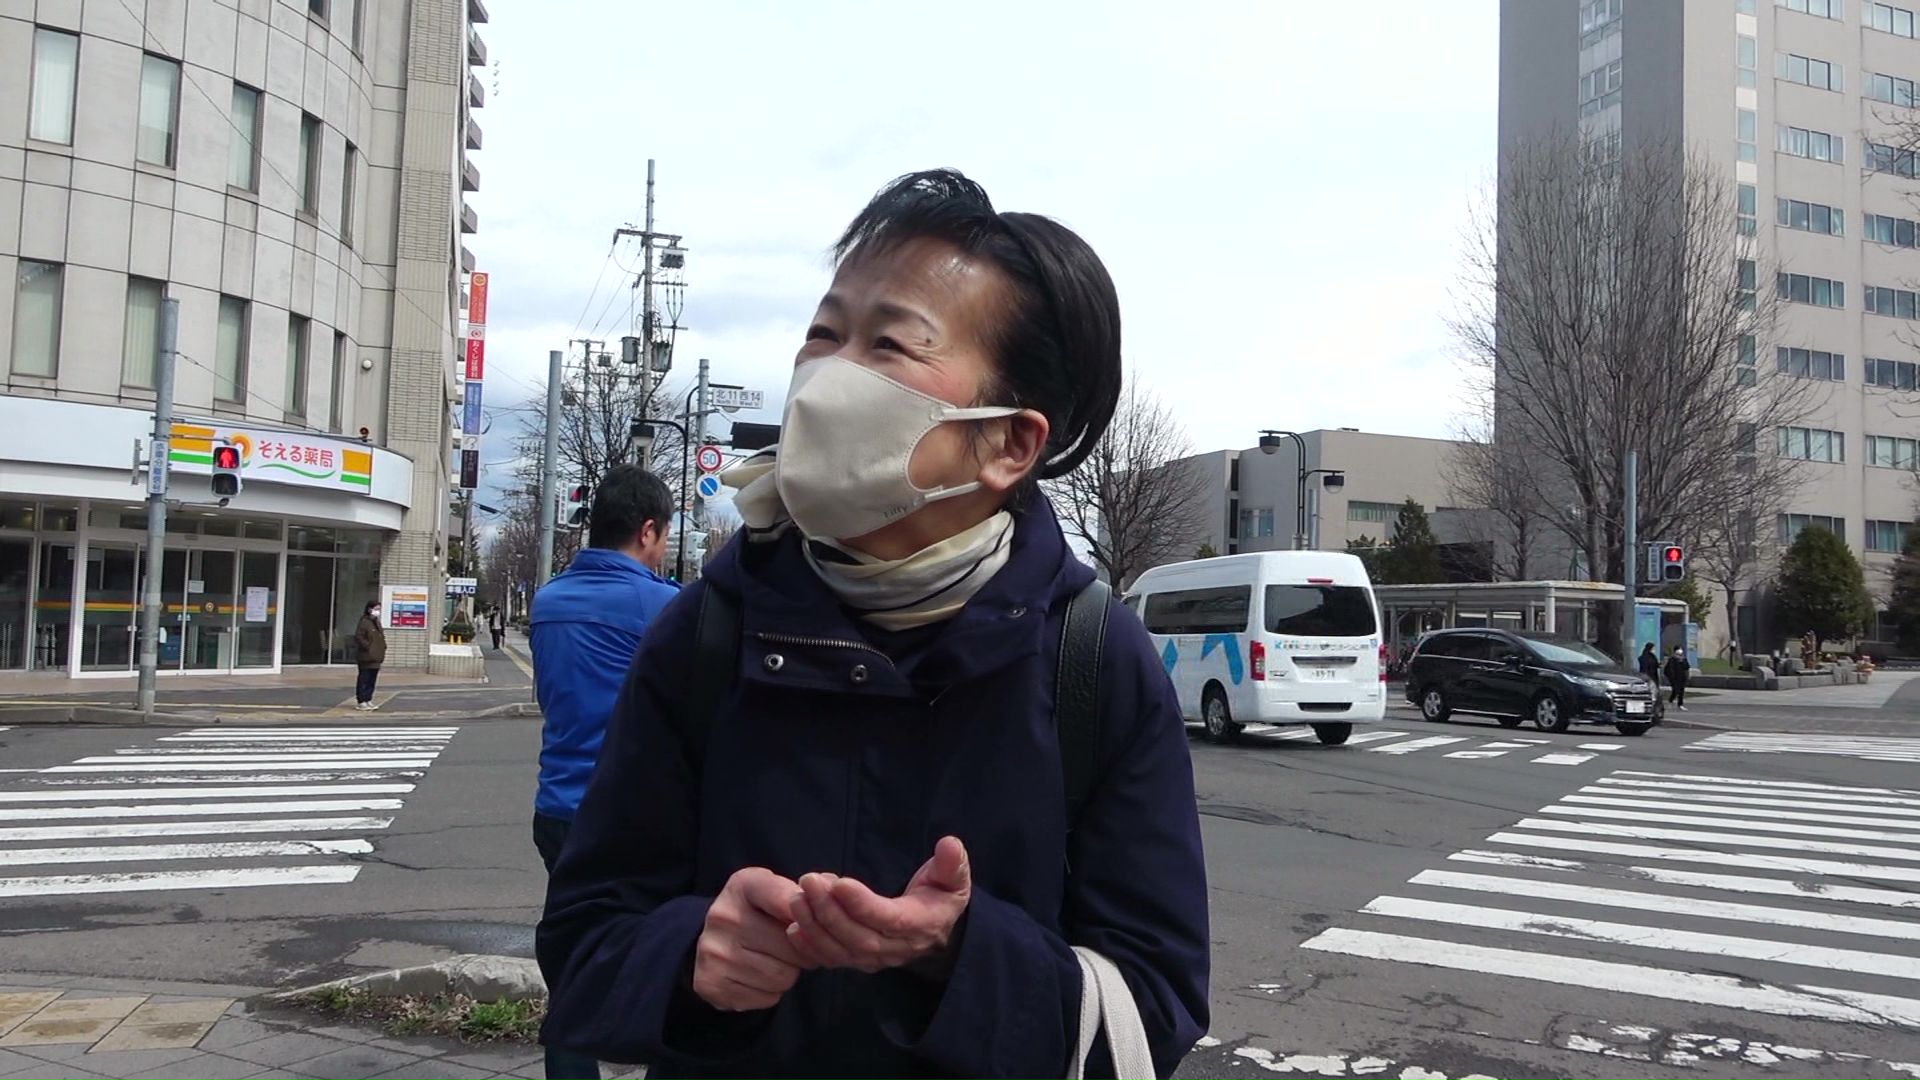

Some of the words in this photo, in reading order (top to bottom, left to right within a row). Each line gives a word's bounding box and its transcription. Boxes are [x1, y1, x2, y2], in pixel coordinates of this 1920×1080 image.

[716, 389, 761, 401] 北11西14
[258, 440, 334, 468] そえる薬局
[703, 453, 716, 465] 50
